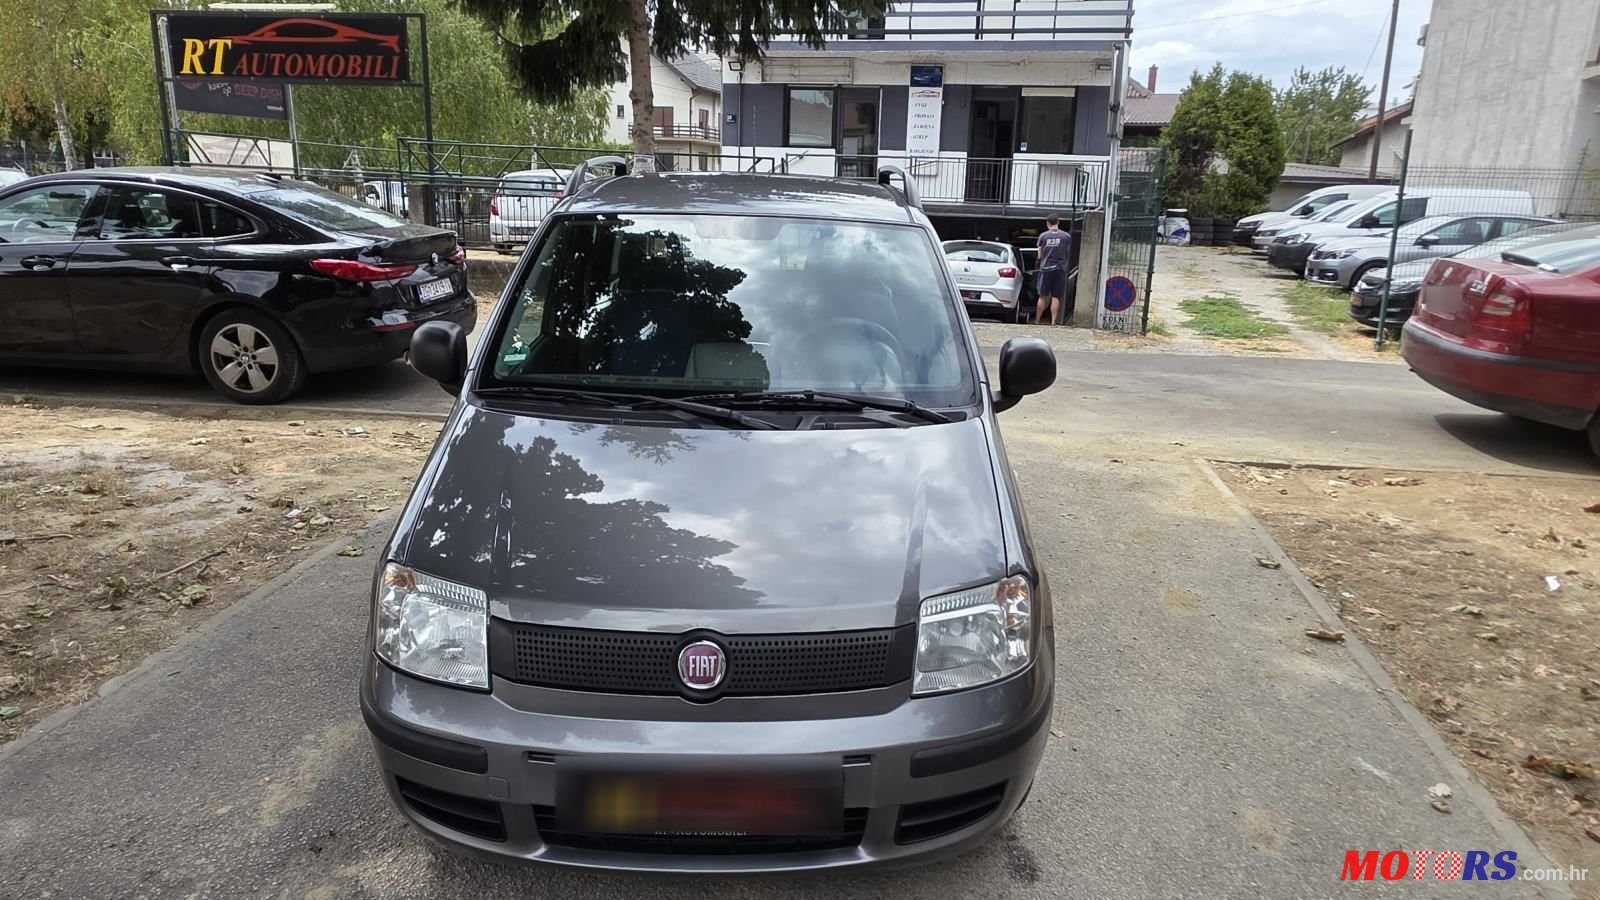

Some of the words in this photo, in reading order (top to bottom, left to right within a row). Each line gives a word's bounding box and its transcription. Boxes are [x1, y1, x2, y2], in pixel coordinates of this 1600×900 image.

[179, 38, 232, 75] RT
[232, 52, 401, 79] AUTOMOBILI
[689, 655, 717, 678] FIAT
